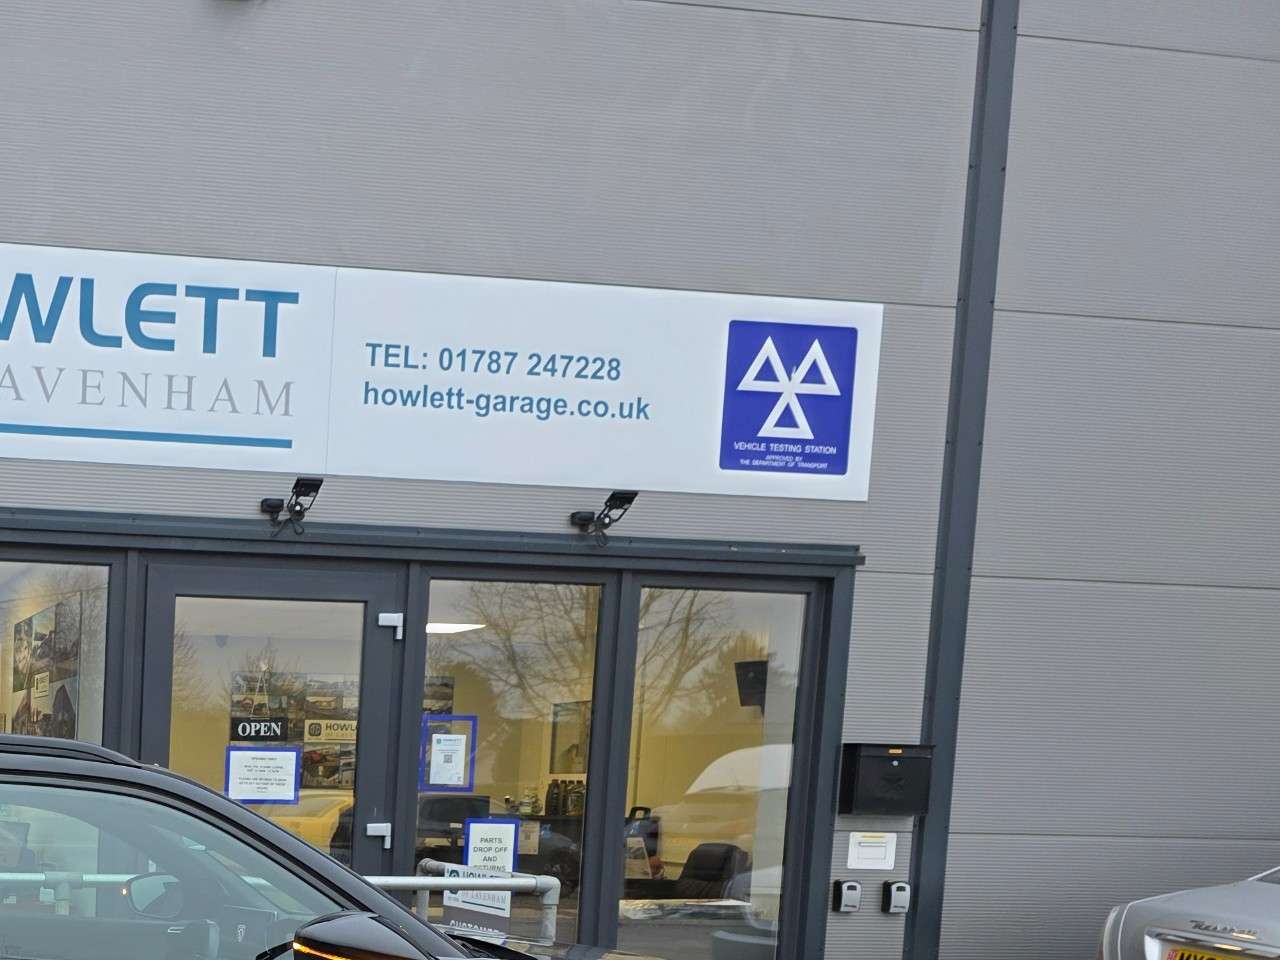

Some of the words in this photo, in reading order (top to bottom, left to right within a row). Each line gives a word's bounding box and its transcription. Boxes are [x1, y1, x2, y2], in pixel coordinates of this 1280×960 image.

[365, 342, 429, 370] TEL:
[438, 347, 518, 376] 01787
[527, 352, 622, 381] 247228
[363, 381, 651, 420] howlett-garage.co.uk
[734, 441, 767, 451] VEHICLE
[769, 443, 802, 453] TESTING
[804, 445, 837, 455] STATION
[237, 722, 282, 737] OPEN
